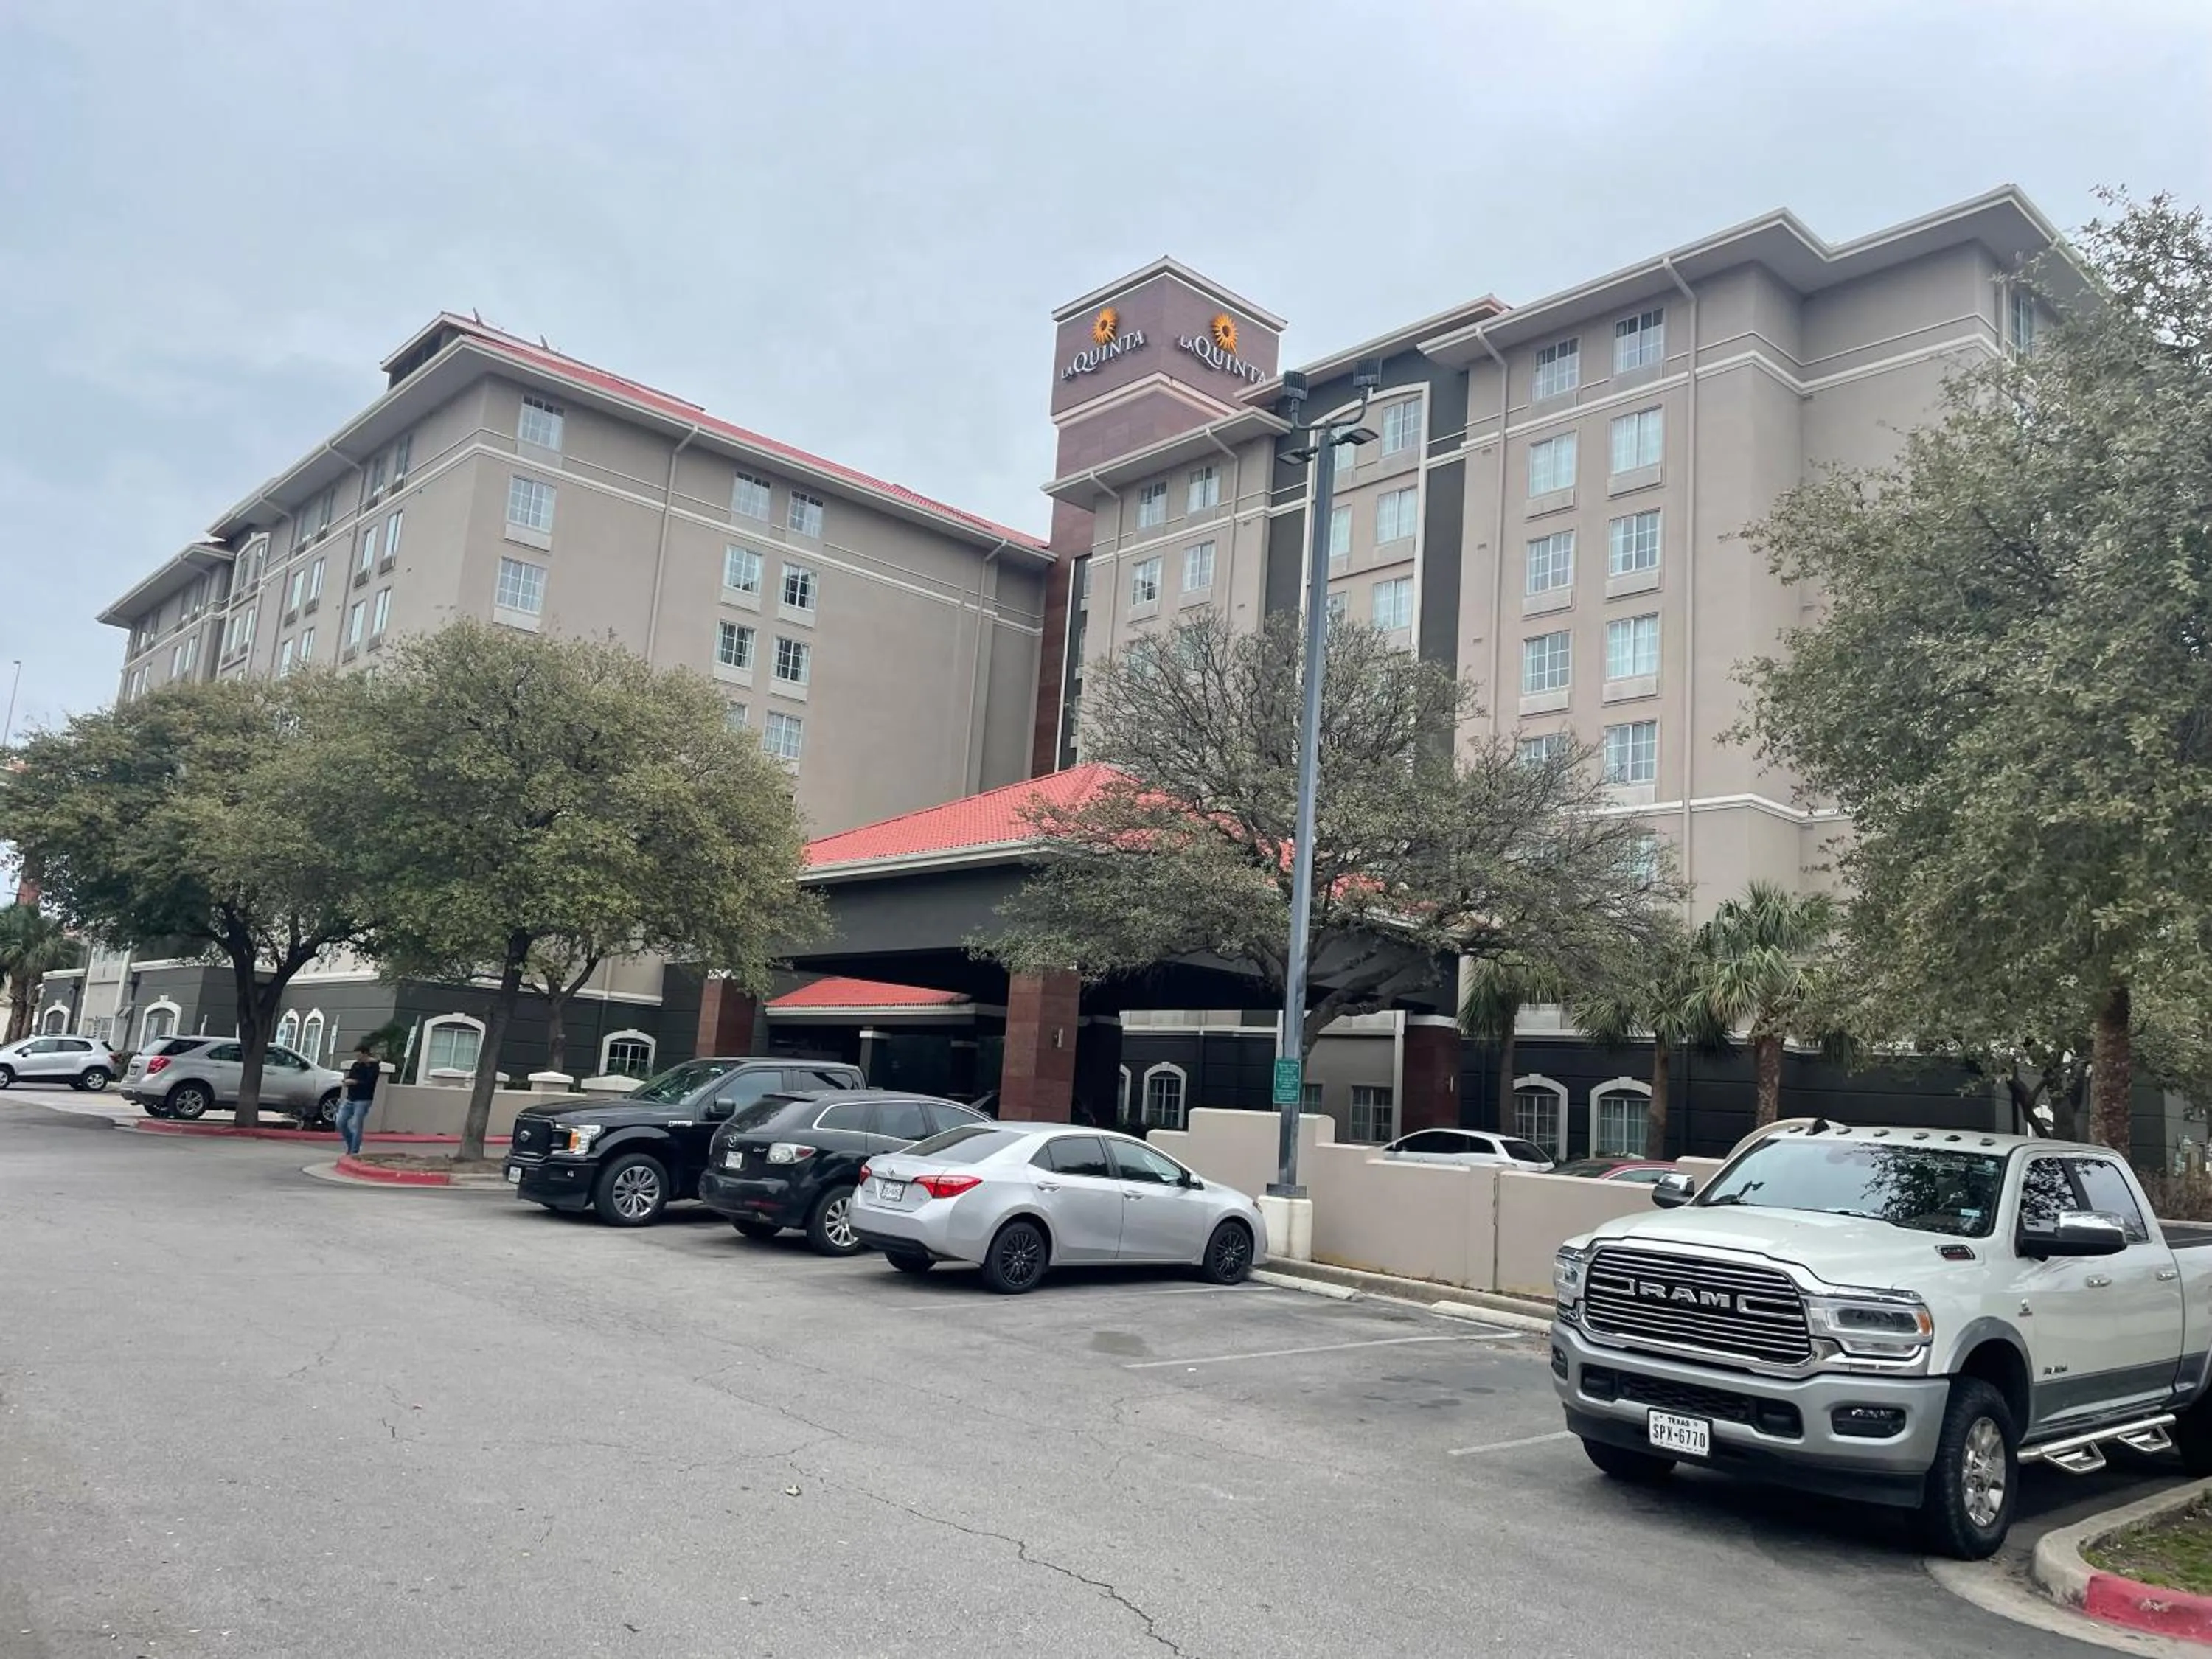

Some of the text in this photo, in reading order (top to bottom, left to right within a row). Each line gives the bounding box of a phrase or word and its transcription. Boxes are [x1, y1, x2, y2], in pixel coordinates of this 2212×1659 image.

[1060, 330, 1144, 379] LA QUINTA
[1180, 335, 1267, 383] LA QUINTA
[1639, 1281, 1731, 1307] RAM
